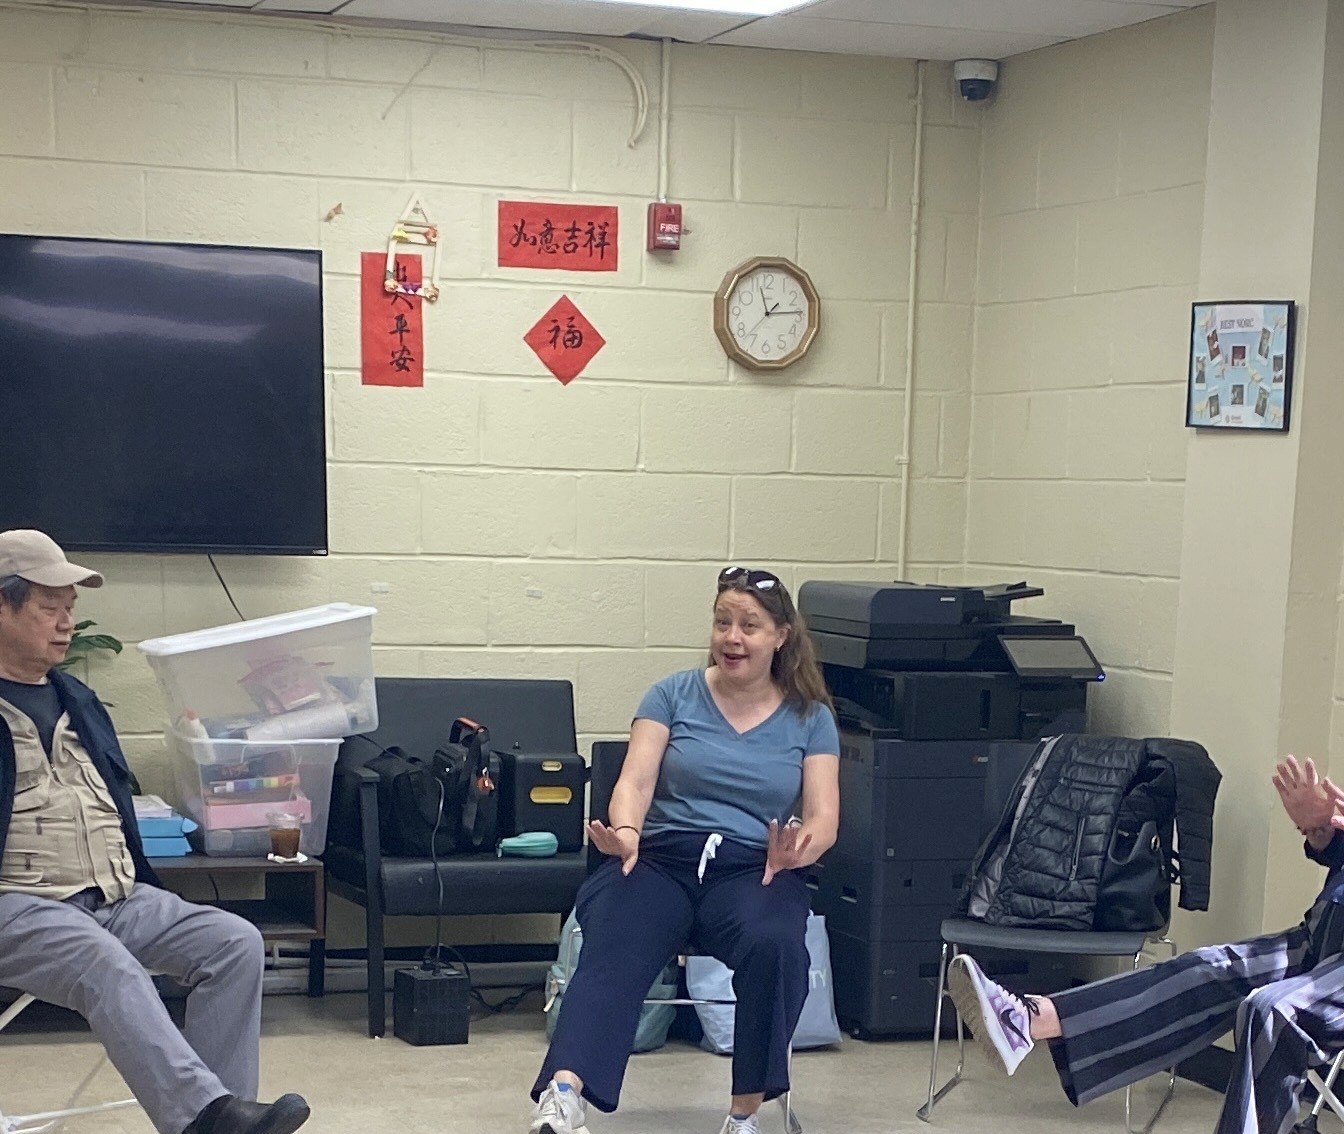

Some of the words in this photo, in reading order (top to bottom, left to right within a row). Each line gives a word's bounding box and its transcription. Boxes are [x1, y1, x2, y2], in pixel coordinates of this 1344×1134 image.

[660, 223, 680, 233] FIRE
[509, 218, 611, 260] 如意吉祥
[763, 274, 774, 289] 12
[789, 291, 797, 306] 2
[548, 316, 583, 350] 福
[737, 322, 745, 338] 8
[749, 334, 758, 347] 7
[761, 340, 770, 353] 6
[777, 334, 786, 350] 5
